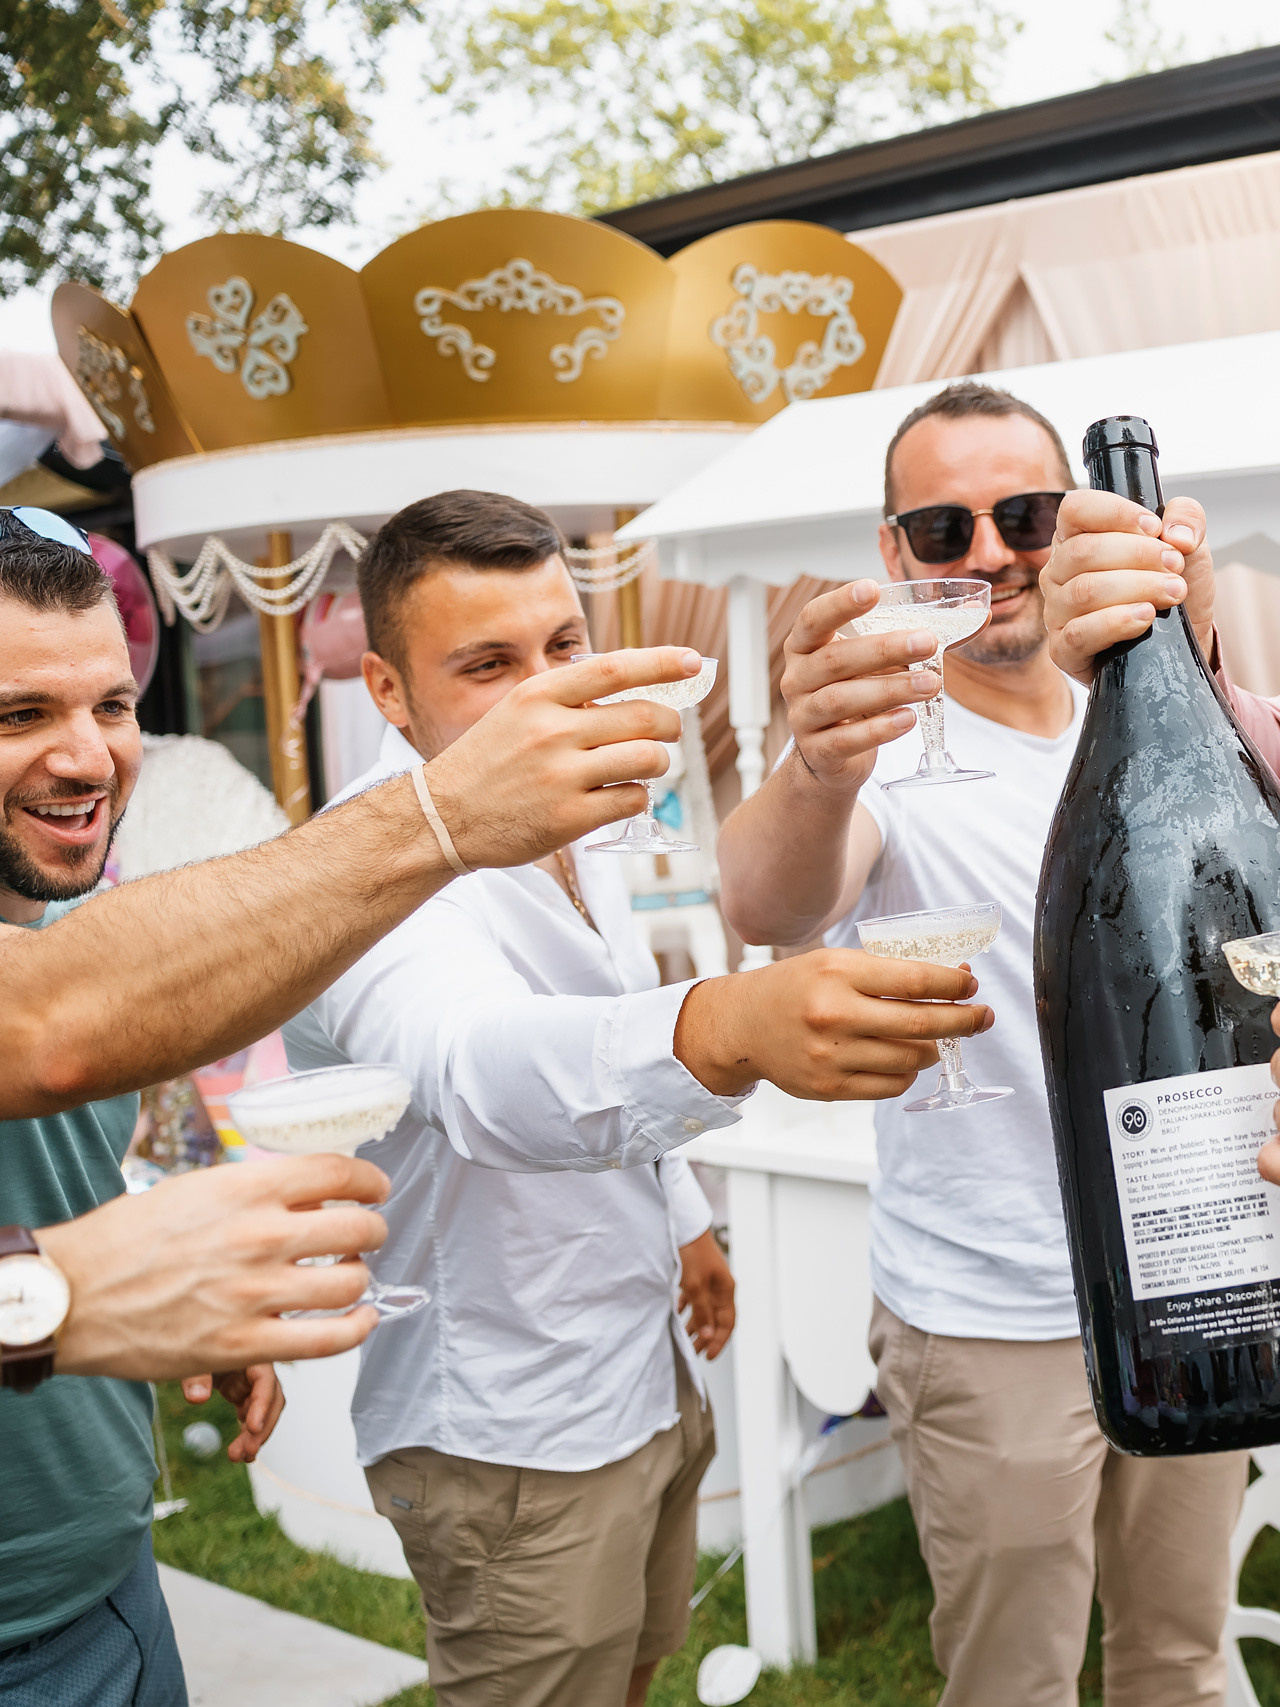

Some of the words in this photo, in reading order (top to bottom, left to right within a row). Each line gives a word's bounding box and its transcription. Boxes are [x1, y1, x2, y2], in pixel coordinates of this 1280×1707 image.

[1157, 1086, 1222, 1105] PROSECCO
[1158, 1100, 1222, 1116] DENOMINAZIONE
[1233, 1094, 1263, 1104] ORIGINE
[1160, 1115, 1188, 1126] ITALIAN
[1190, 1108, 1231, 1120] SPARKLING
[1233, 1105, 1253, 1113] WINE
[1162, 1126, 1180, 1135] BRUT
[1124, 1162, 1142, 1170] sipping
[1150, 1156, 1172, 1164] leisurely
[1152, 1171, 1172, 1179] Aromas
[1181, 1167, 1195, 1175] fresh
[1197, 1163, 1220, 1173] peaches
[1129, 1196, 1146, 1204] tongue
[1239, 1178, 1253, 1186] crisp
[1142, 1184, 1154, 1192] Once
[1186, 1176, 1205, 1184] shower
[1138, 1251, 1160, 1260] IMPORTED
[1167, 1247, 1188, 1256] LATITUDE
[1190, 1242, 1215, 1252] BEVERAGE
[1139, 1261, 1163, 1269] PRODUCED
[1140, 1270, 1160, 1278] PRODUCT
[1201, 1261, 1221, 1269] ALC/VOL
[1142, 1281, 1165, 1290] CONTAINS
[1166, 1277, 1190, 1286] SULFITES
[1196, 1272, 1222, 1282] CONTIENE
[1224, 1268, 1245, 1277] SOLFITI
[1236, 1316, 1252, 1324] Great
[1226, 1327, 1241, 1335] Read
